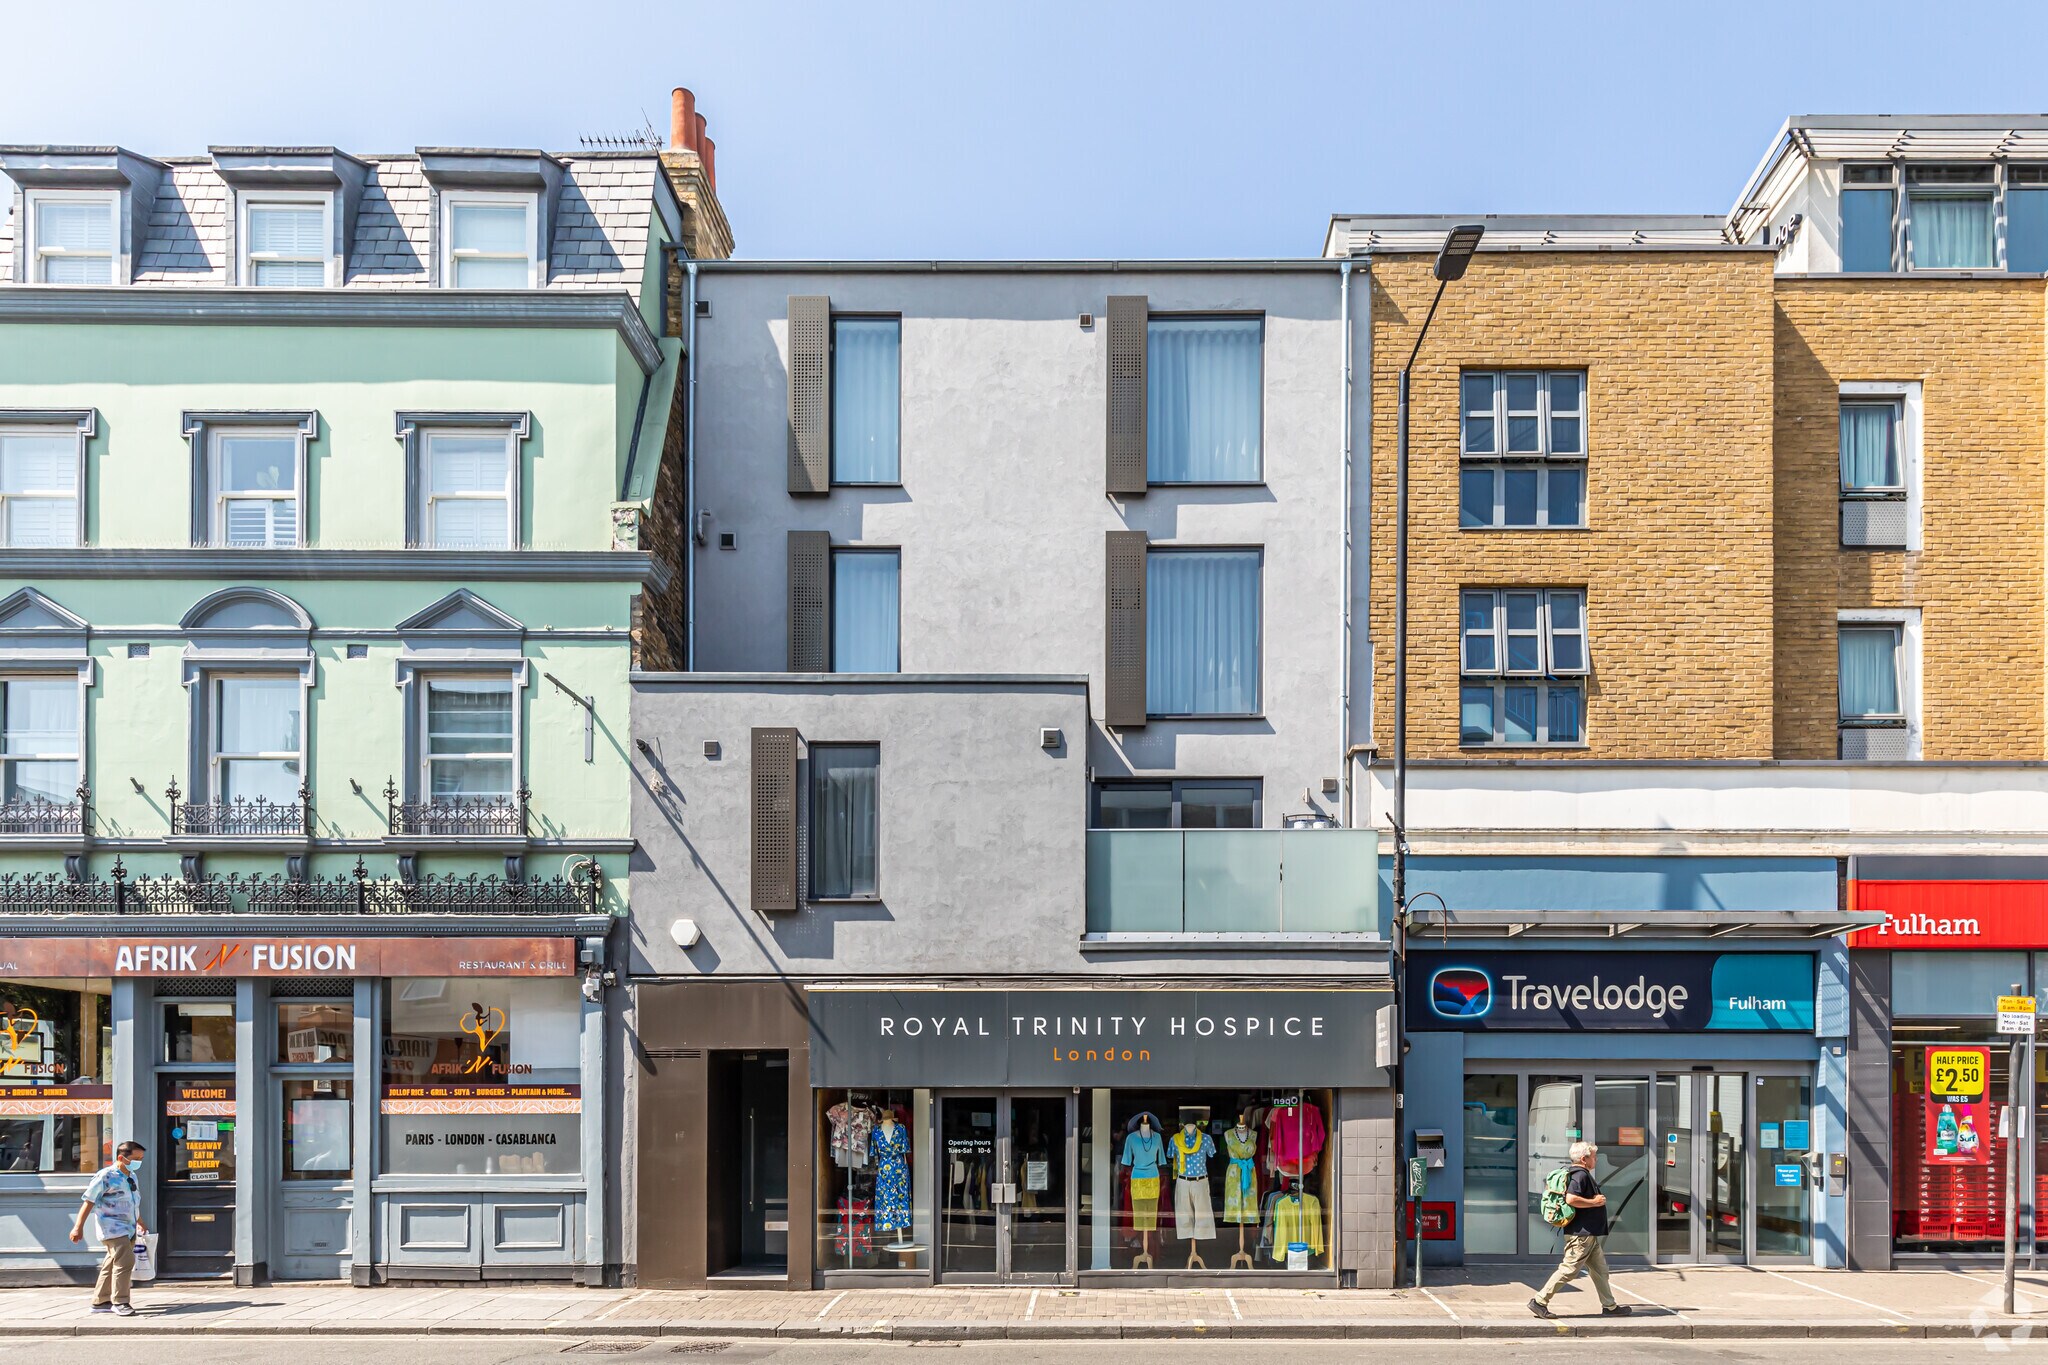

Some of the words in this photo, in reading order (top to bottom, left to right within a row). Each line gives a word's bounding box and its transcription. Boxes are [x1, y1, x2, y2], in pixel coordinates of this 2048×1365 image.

[1878, 913, 1980, 935] Fulham
[115, 945, 197, 971] AFRIK
[252, 944, 356, 971] FUSION
[459, 961, 525, 970] RESTAURANT
[530, 961, 536, 970] &
[539, 961, 567, 970] GRILL
[1502, 975, 1688, 1018] Travelodge
[1729, 996, 1786, 1010] Fulham
[880, 1017, 990, 1036] ROYAL
[1012, 1017, 1149, 1036] TRINITY
[1171, 1017, 1324, 1036] HOSPICE
[1053, 1047, 1151, 1062] London
[1936, 1056, 1955, 1065] HALF
[1957, 1056, 1979, 1065] PRICE
[25, 1063, 65, 1074] FUSION
[431, 1063, 463, 1074] AFRIK
[492, 1063, 533, 1074] FUSION
[1936, 1068, 1979, 1092] £2.50
[12, 1088, 37, 1096] BRUNCH
[43, 1088, 68, 1096] DINNER
[182, 1088, 227, 1099] WELCOME!
[389, 1089, 411, 1097] JOLLOF
[411, 1088, 424, 1096] RICE
[430, 1088, 448, 1096] GRILL
[454, 1088, 470, 1096] SUYA
[476, 1088, 505, 1096] BURGERS
[511, 1088, 541, 1096] PLANTAIN
[405, 1133, 435, 1145] PARIS
[445, 1133, 485, 1145] LONDON
[495, 1133, 557, 1145] CASABLANCA
[948, 1139, 974, 1147] Opening
[1959, 1134, 1976, 1142] Surf
[186, 1142, 222, 1150] TAKEAWAY
[193, 1151, 206, 1159] EAT
[206, 1151, 214, 1159] IN
[187, 1160, 221, 1168] DELIVERY
